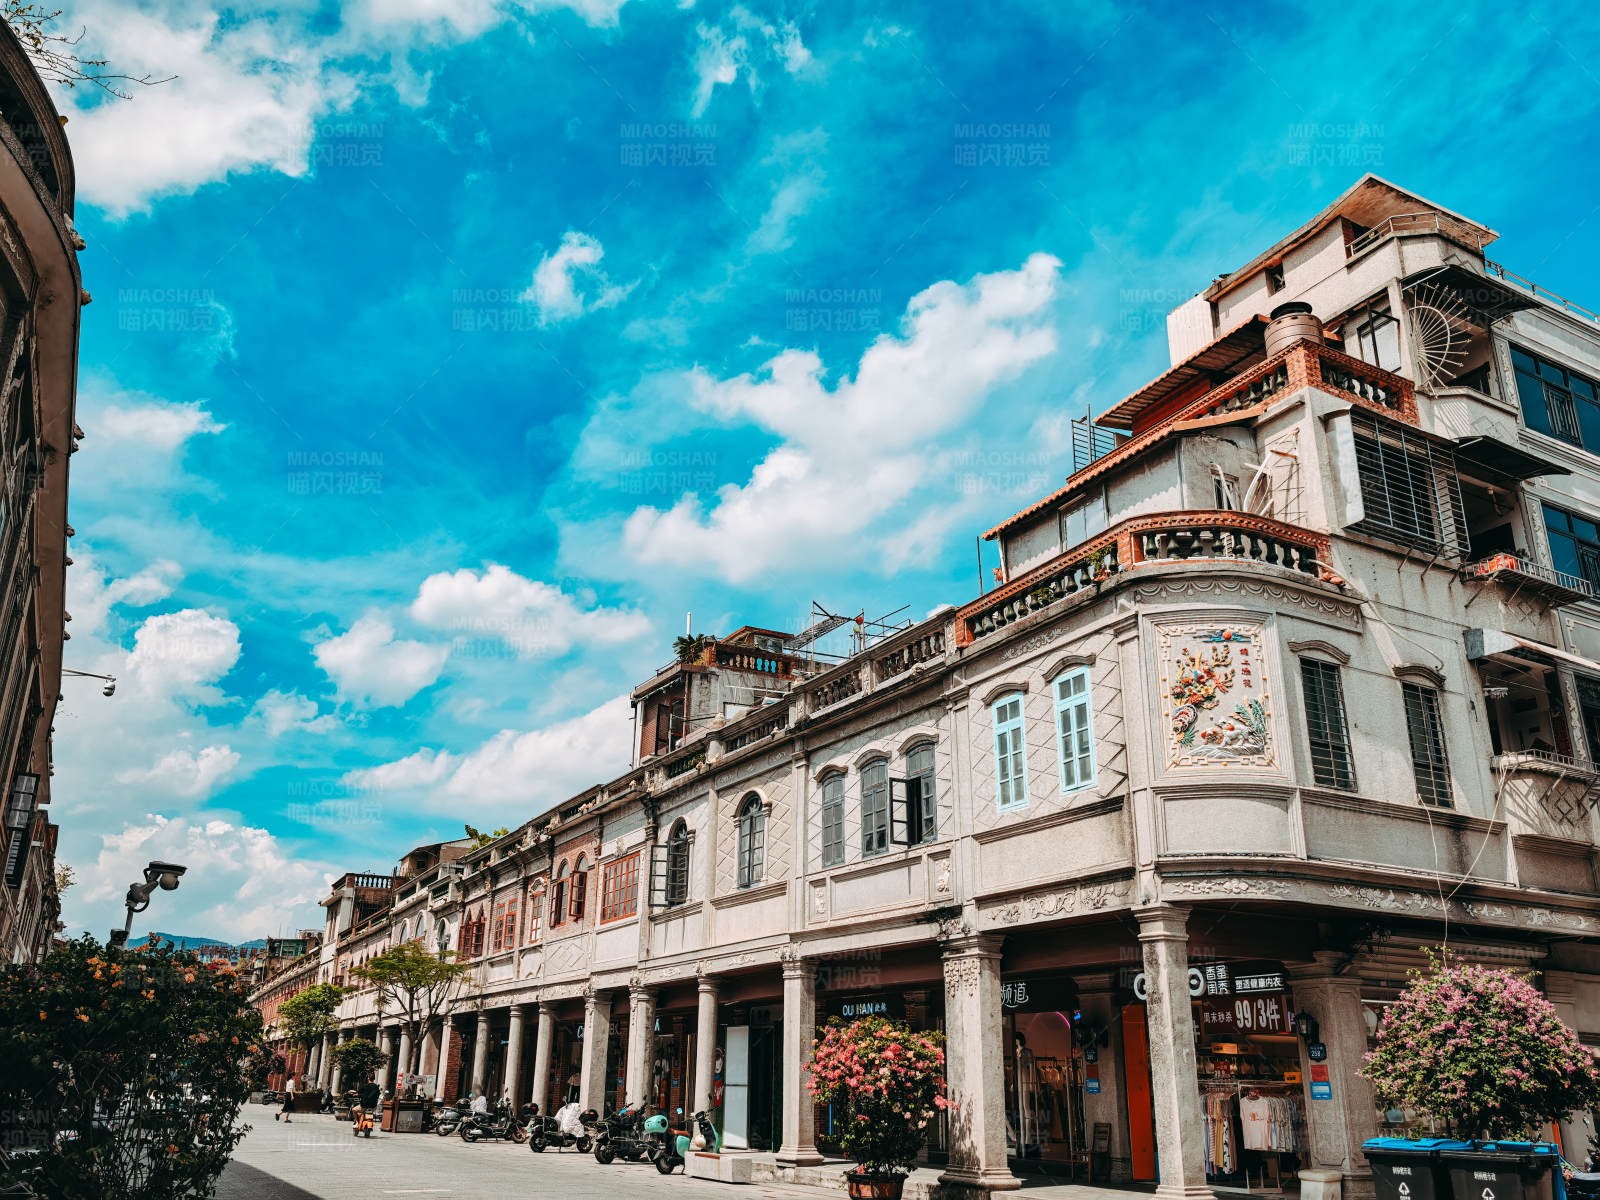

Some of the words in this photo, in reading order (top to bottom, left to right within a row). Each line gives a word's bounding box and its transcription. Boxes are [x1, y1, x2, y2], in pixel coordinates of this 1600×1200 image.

[1203, 1011, 1233, 1024] 周末秒杀
[1234, 997, 1281, 1031] 99/3件
